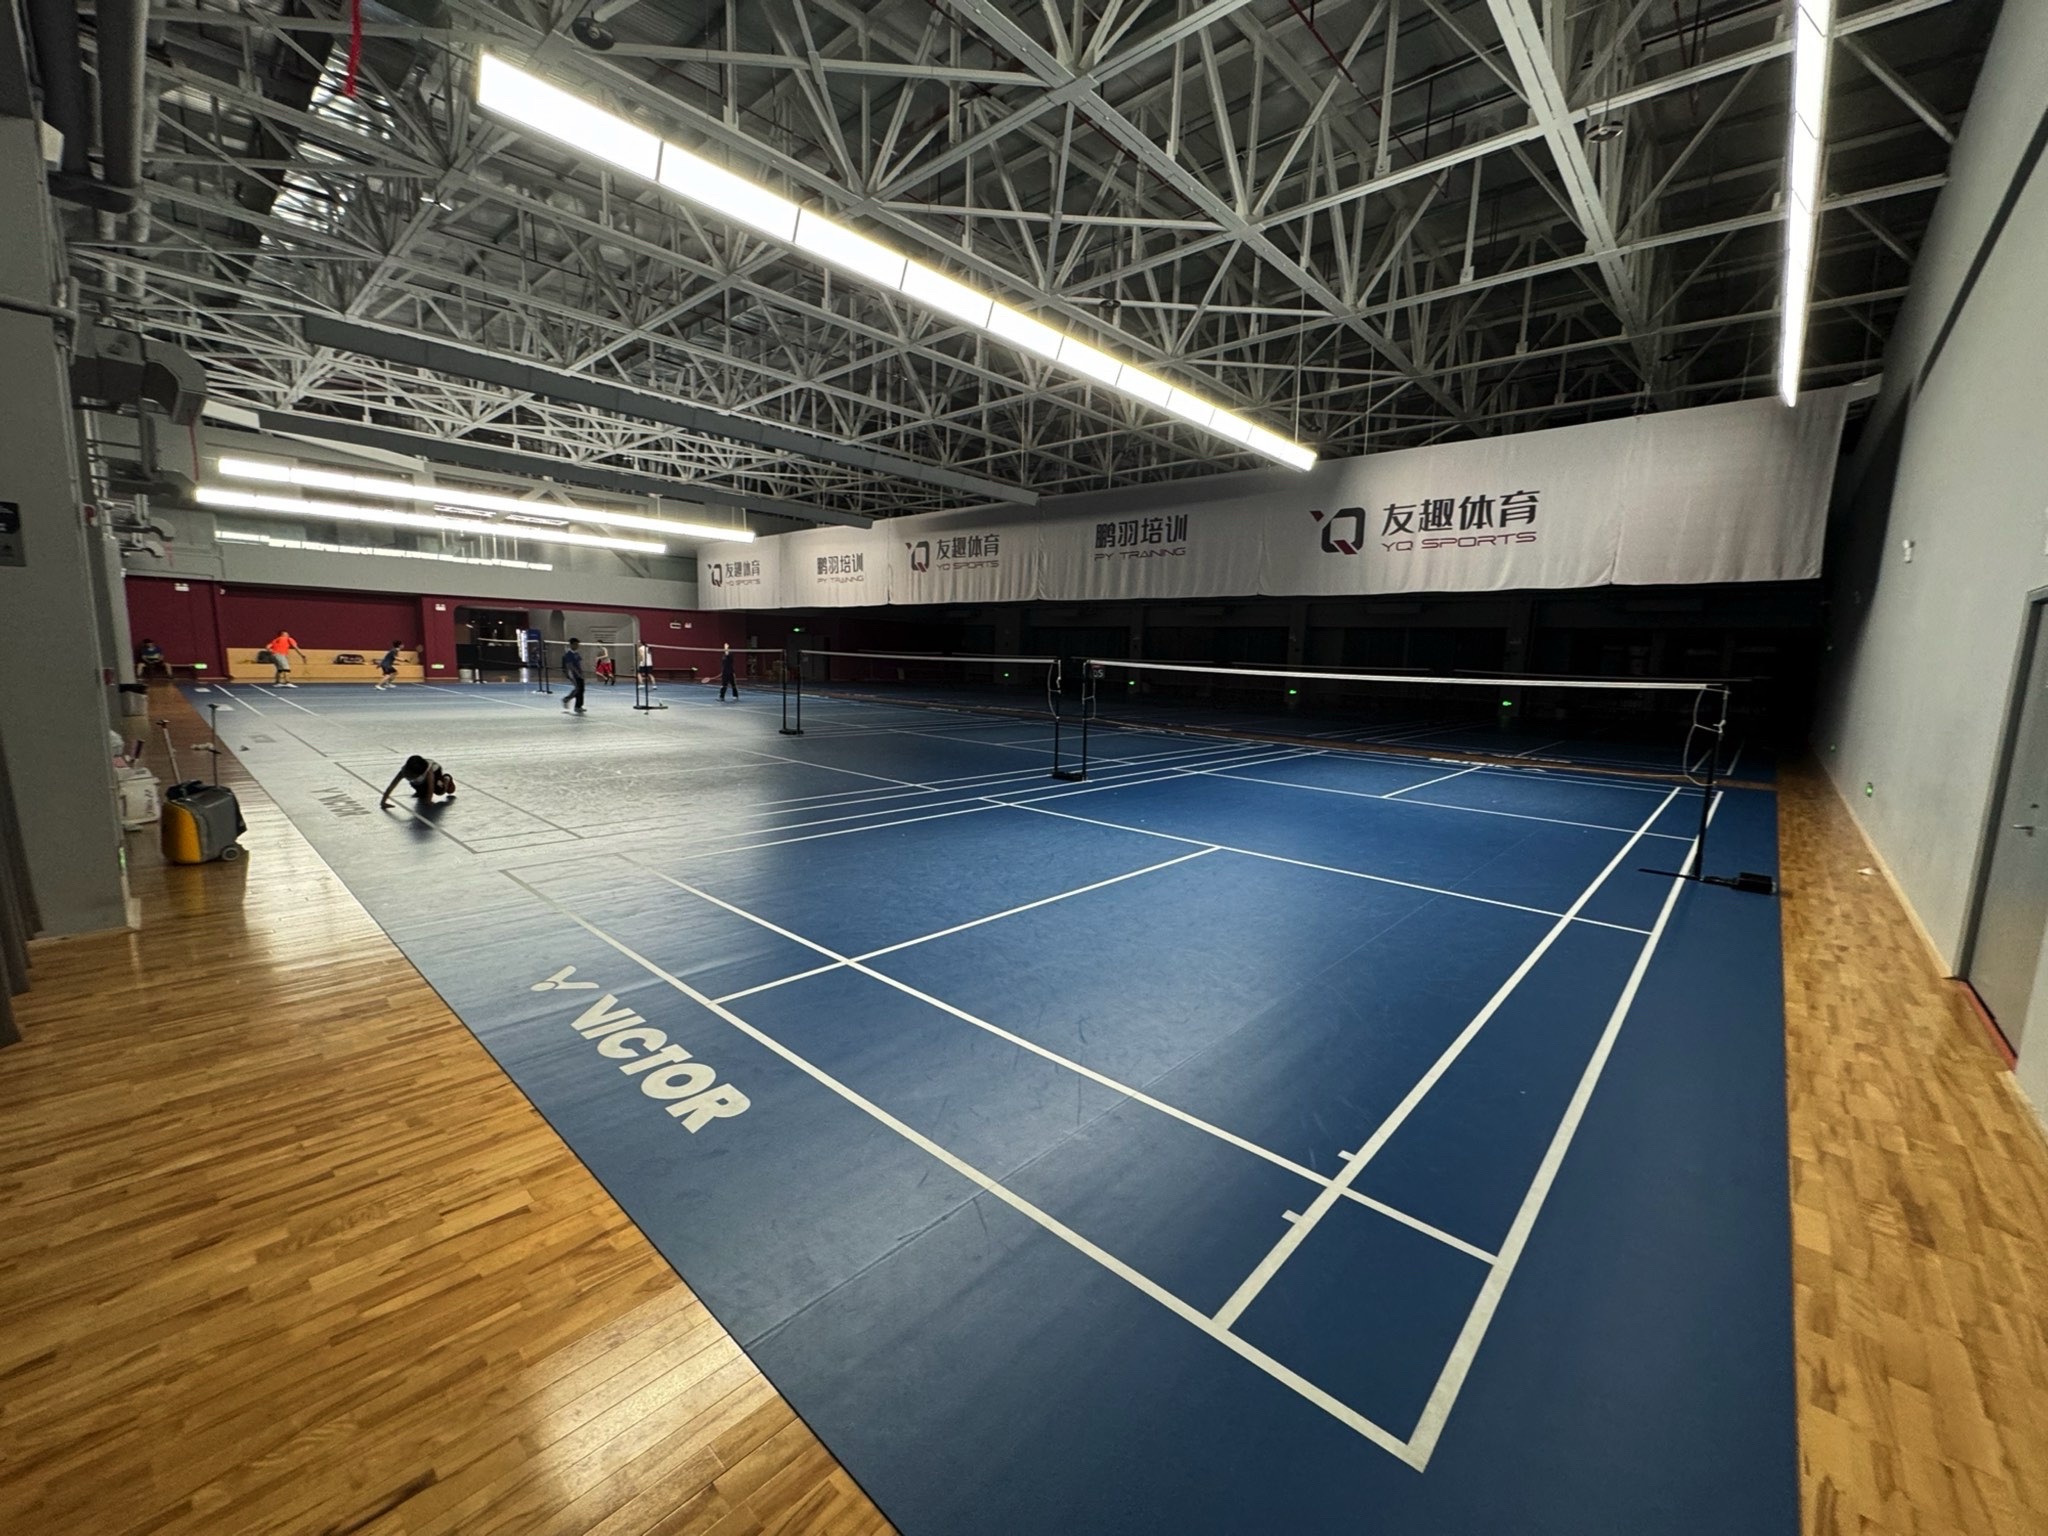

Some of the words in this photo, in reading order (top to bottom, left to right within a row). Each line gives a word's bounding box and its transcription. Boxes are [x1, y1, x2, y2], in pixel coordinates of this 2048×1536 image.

[1381, 490, 1541, 537] 友趣体育
[1095, 514, 1188, 549] 鹏羽培训
[1421, 531, 1537, 550] SPORTS
[936, 533, 1000, 560] 友趣体育
[1094, 553, 1114, 561] PY
[816, 553, 864, 575] 鹏羽培训
[952, 560, 1000, 570] SPORTS
[570, 993, 751, 1134] VICTOR
